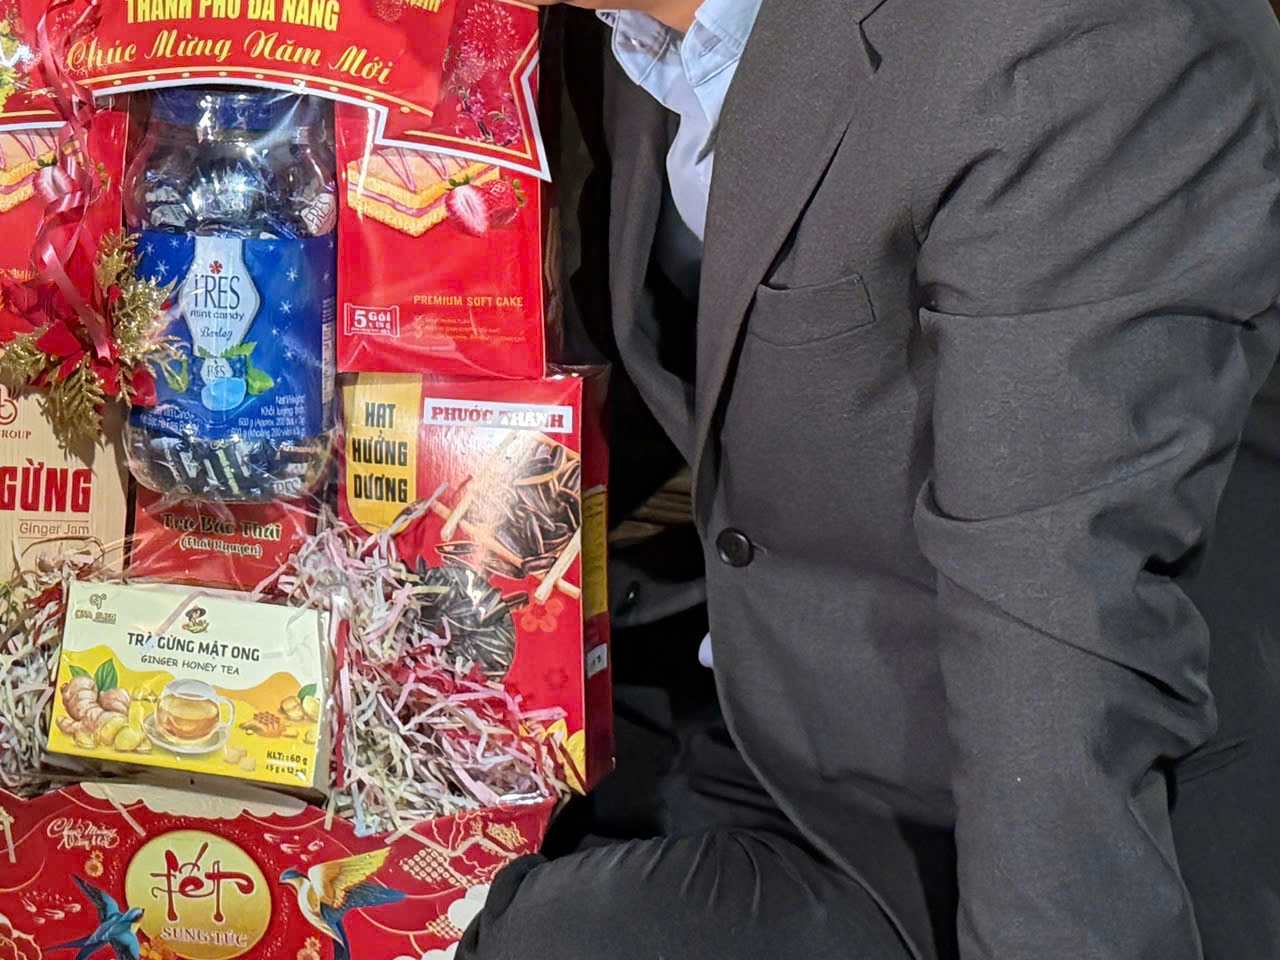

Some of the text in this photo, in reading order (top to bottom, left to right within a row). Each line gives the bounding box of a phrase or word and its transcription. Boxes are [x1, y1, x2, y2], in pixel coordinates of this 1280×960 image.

[67, 29, 394, 85] Chúc Mừng Năm Mới
[413, 294, 524, 307] PREMIUM SOFT CAKE
[190, 309, 245, 321] mint candy
[354, 310, 367, 328] 5
[431, 405, 494, 424] PHƯỚC
[353, 473, 408, 503] DƯƠNG
[20, 522, 89, 537] Ginger Jam
[157, 634, 195, 653] GỪNG
[198, 639, 228, 660] MẬT
[231, 646, 260, 662] ONG
[140, 654, 240, 676] GINGER HONEY TEA
[160, 926, 209, 944] SUNG
